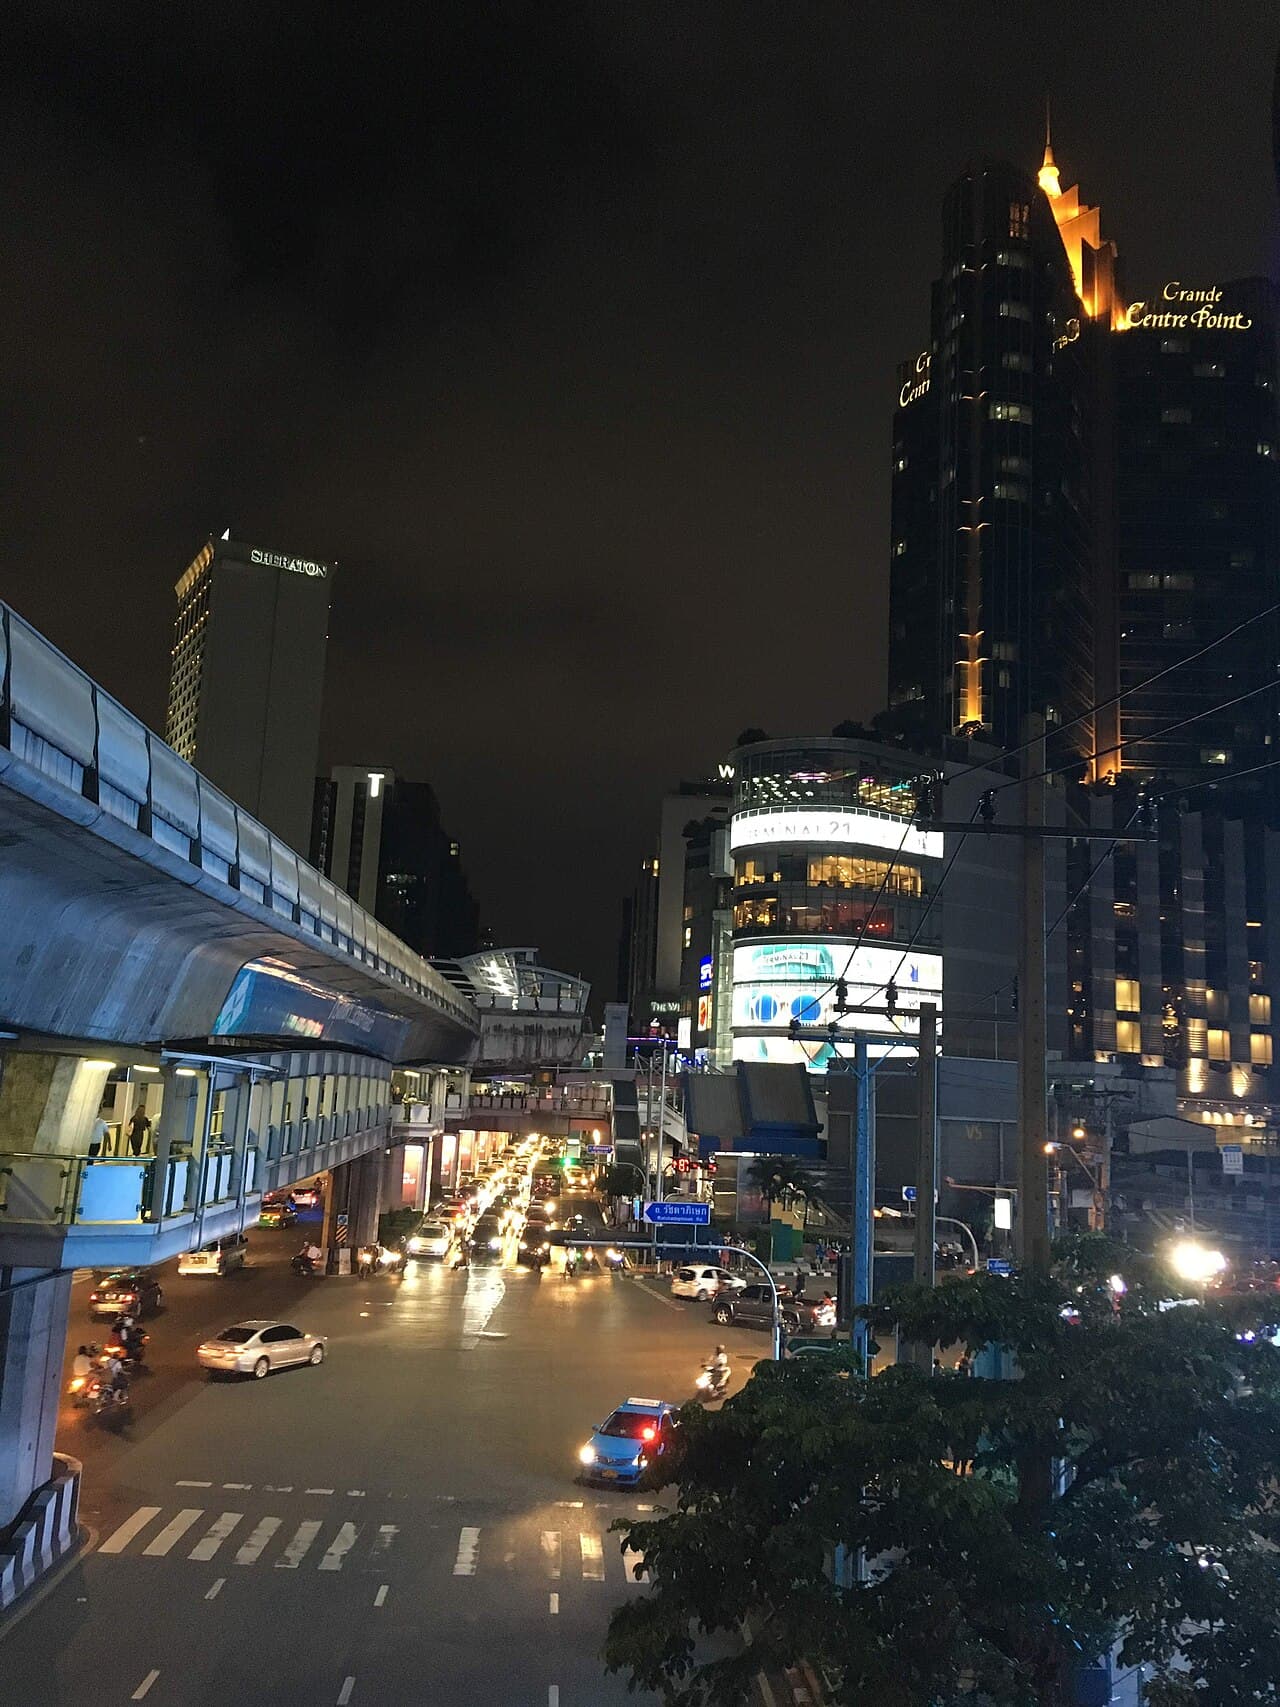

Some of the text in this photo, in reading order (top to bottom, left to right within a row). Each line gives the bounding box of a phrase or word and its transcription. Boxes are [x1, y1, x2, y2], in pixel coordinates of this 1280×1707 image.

[1163, 281, 1223, 303] Grande
[1126, 302, 1252, 329] Centre Point
[250, 549, 327, 578] SHERATON
